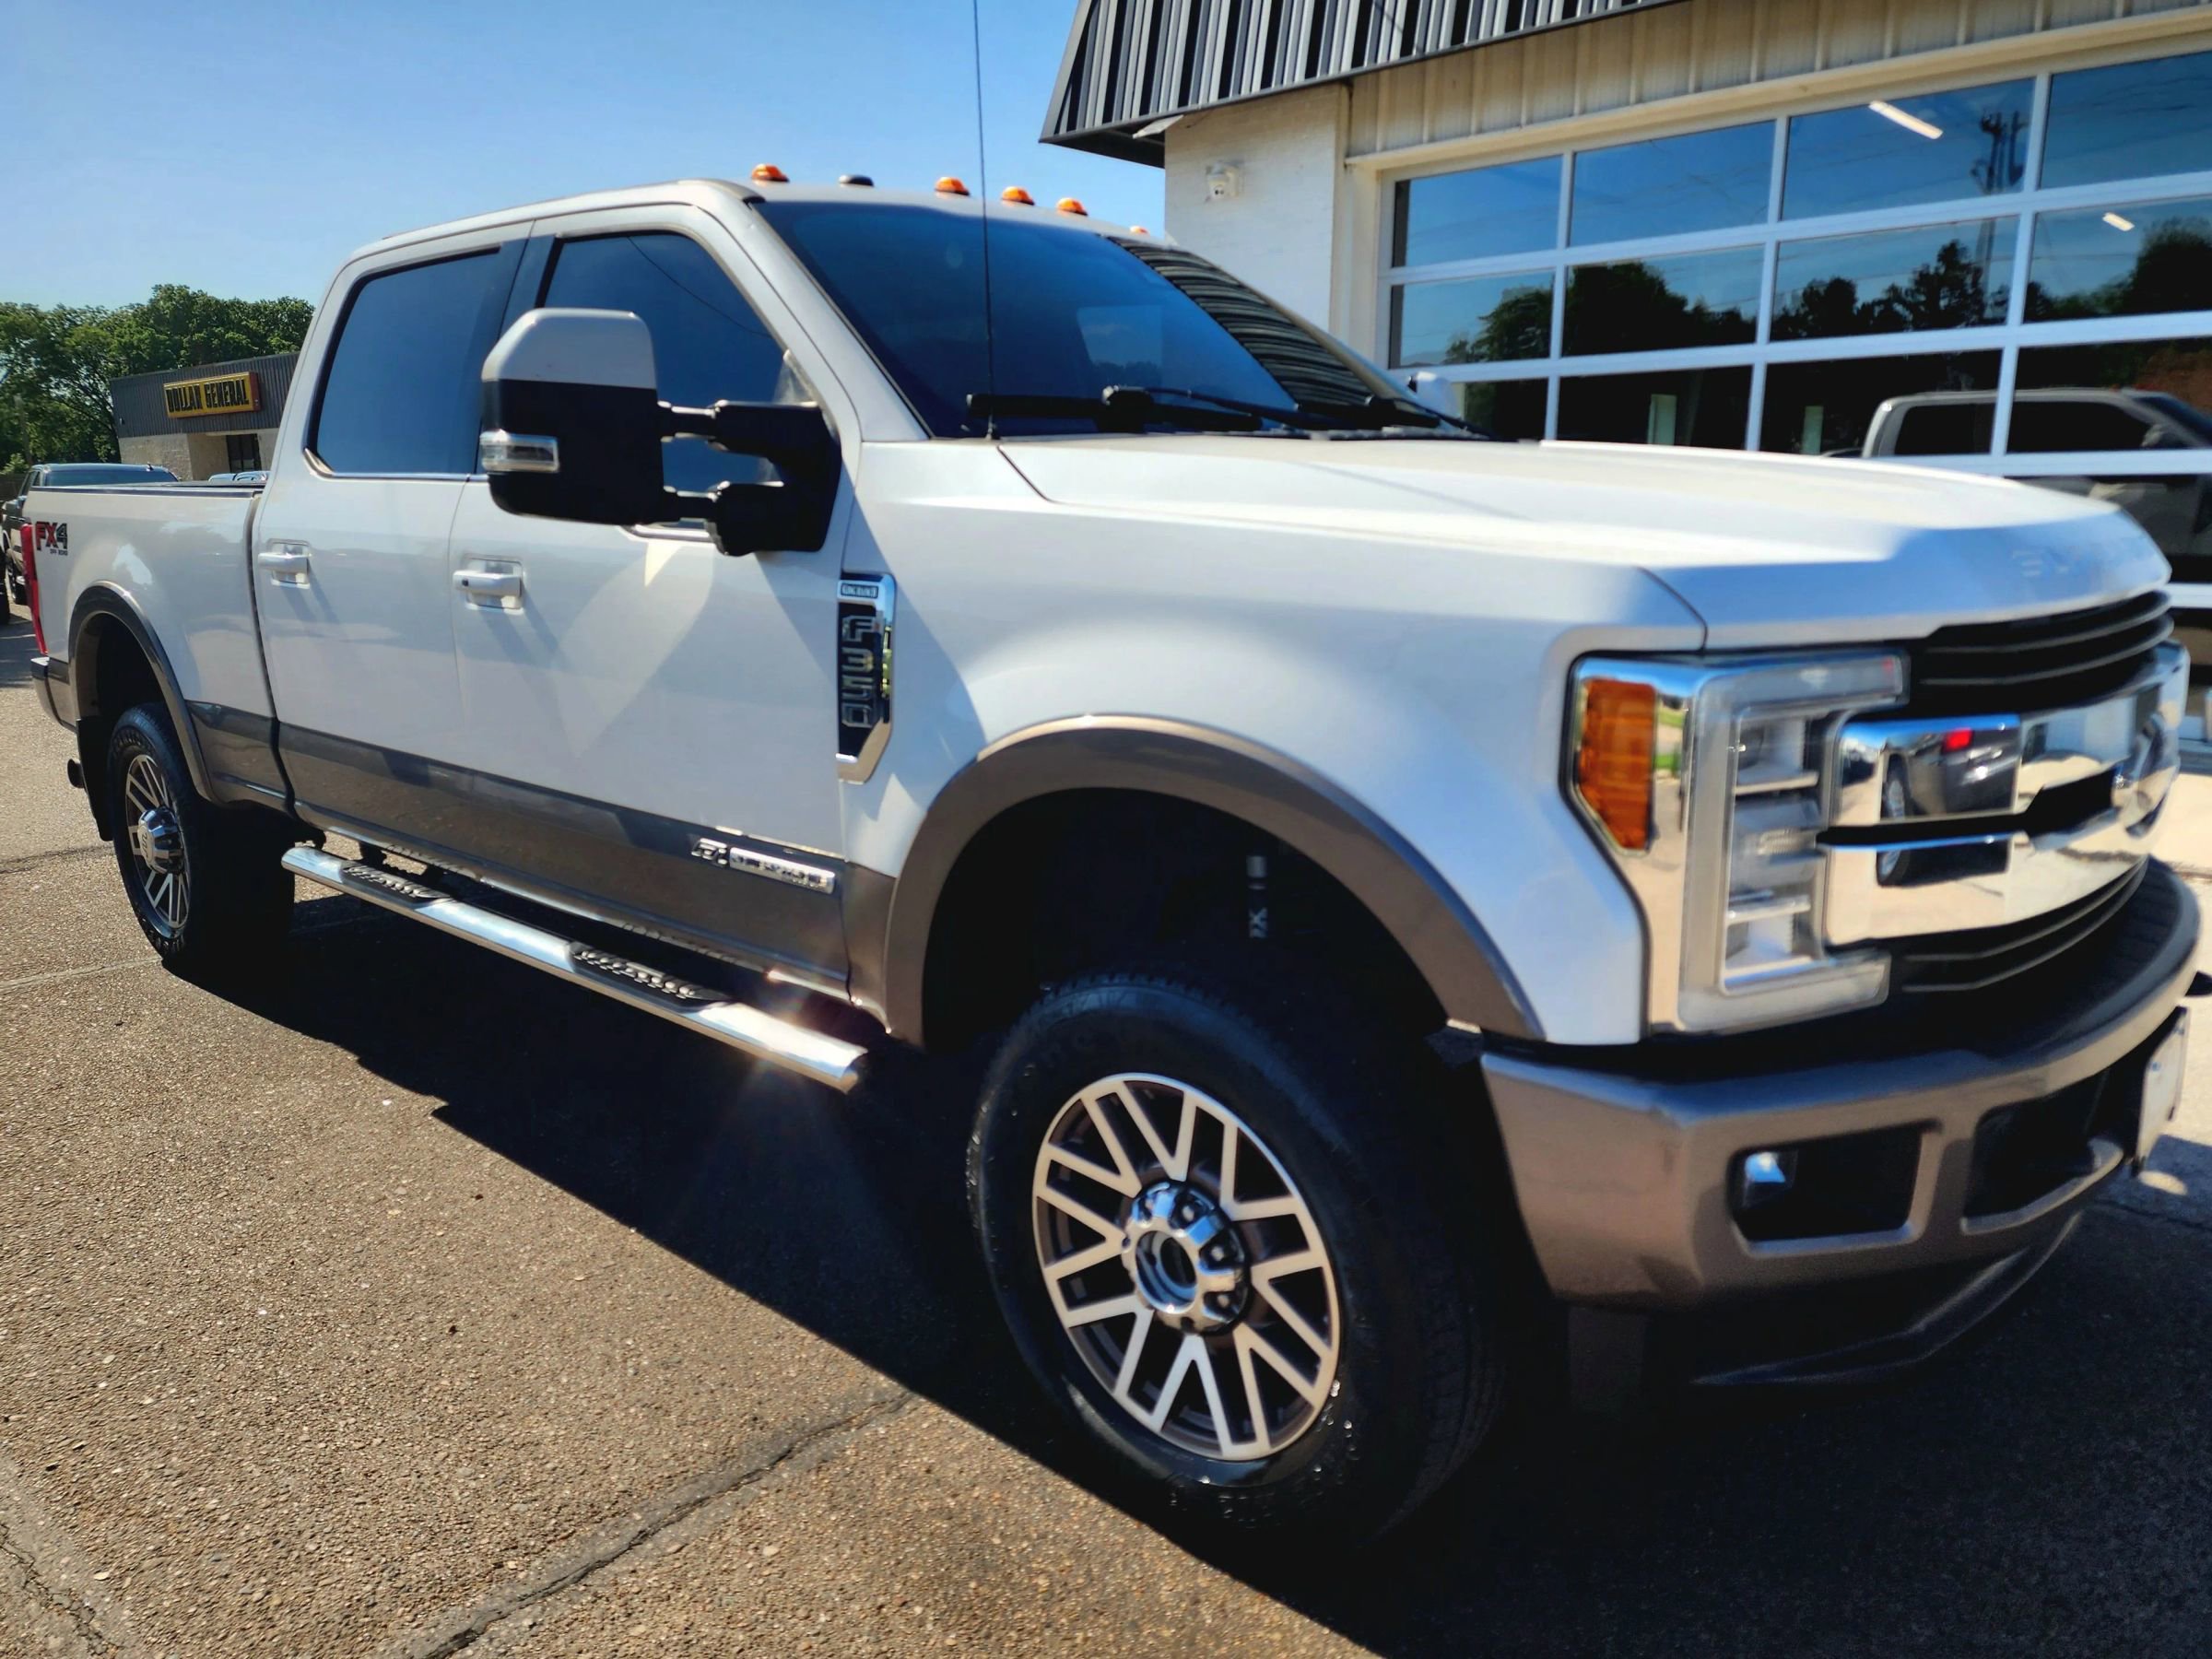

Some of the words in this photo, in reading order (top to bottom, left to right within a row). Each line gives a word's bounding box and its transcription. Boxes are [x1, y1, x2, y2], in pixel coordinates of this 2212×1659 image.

[166, 383, 203, 413] DOLLAR
[204, 378, 250, 408] GENERAL
[35, 521, 68, 551] FX4
